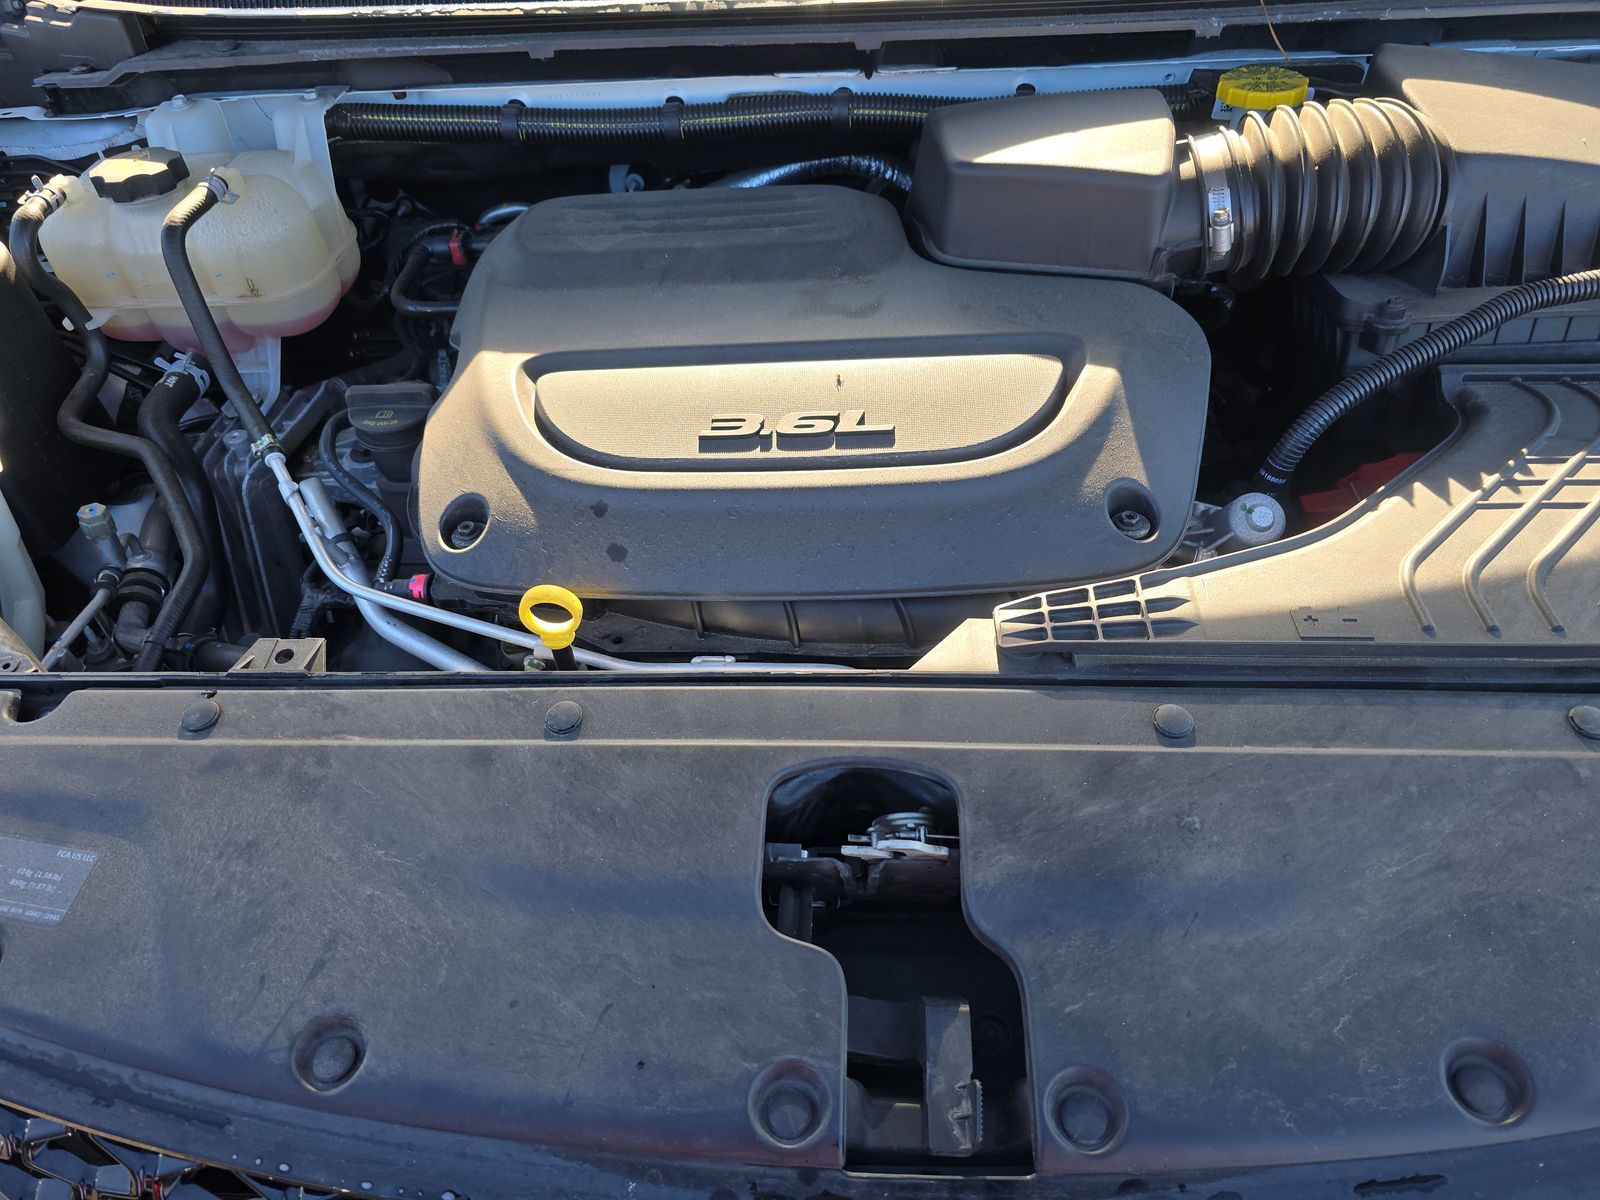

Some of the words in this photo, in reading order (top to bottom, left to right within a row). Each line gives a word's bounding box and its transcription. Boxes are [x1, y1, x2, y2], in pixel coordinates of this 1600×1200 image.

[698, 409, 896, 452] 3.6L
[57, 849, 71, 859] FCA
[72, 852, 82, 861] US
[83, 853, 96, 863] LLC
